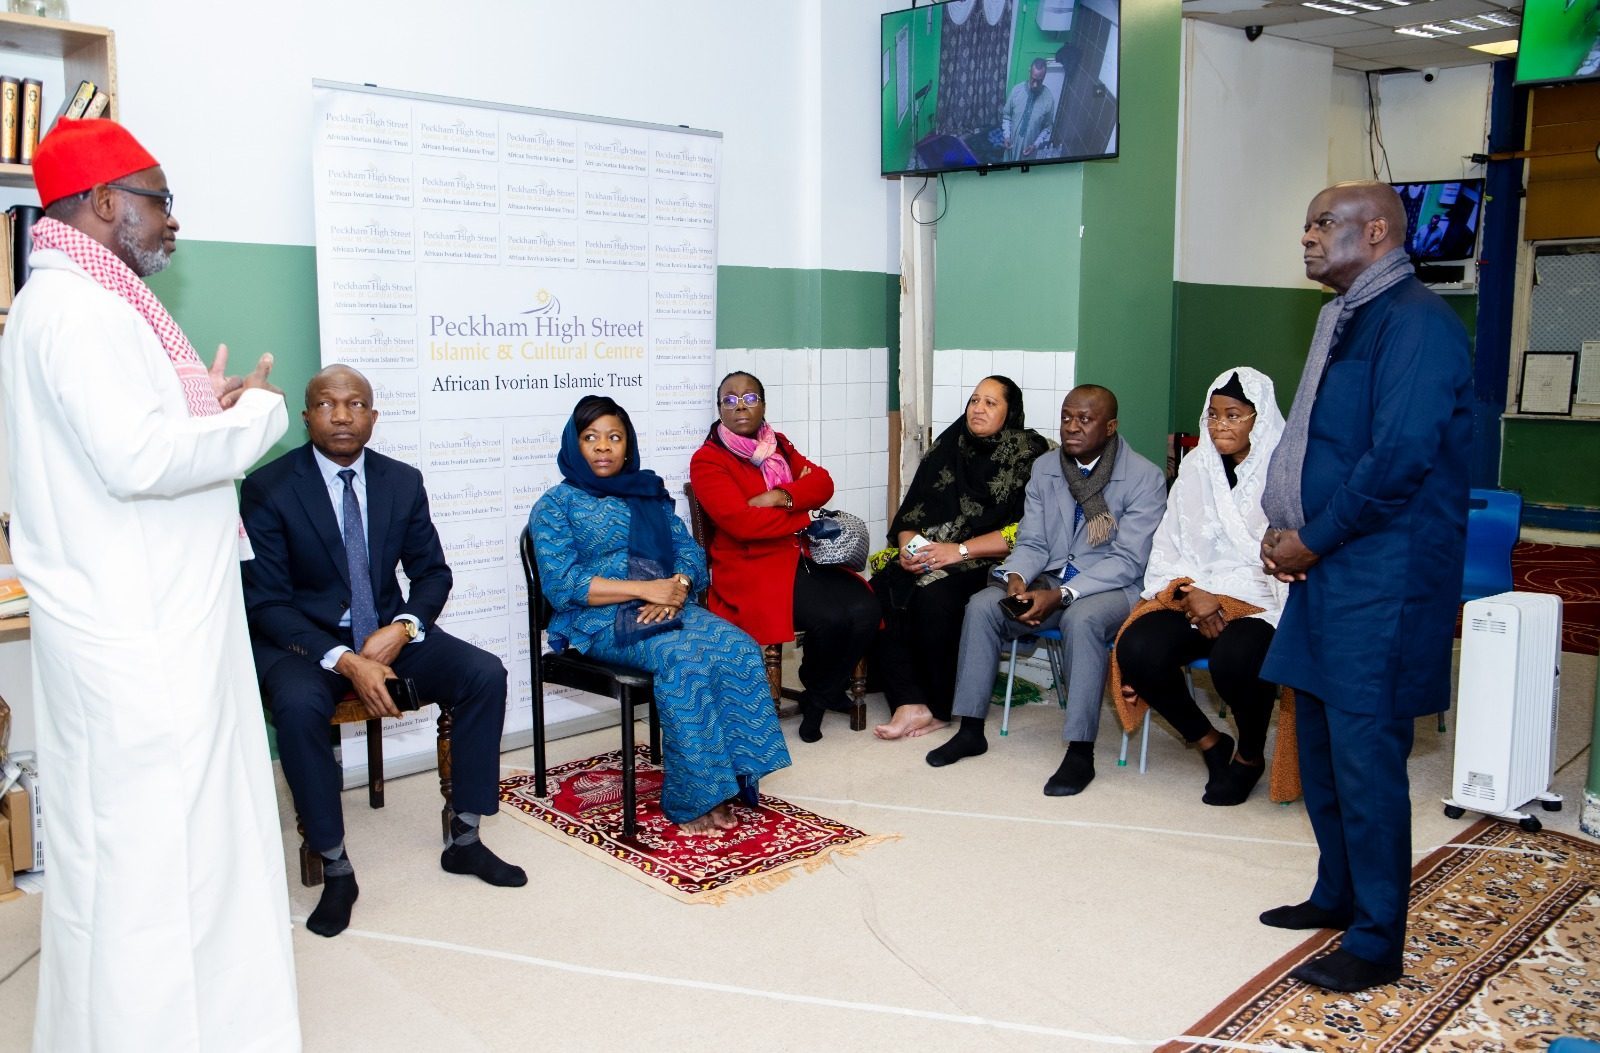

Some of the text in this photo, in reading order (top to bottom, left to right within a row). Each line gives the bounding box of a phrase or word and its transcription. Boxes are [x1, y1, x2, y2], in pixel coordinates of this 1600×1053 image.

[430, 314, 644, 343] Peckham High Street
[430, 341, 644, 360] Islamic & Cultural Centre
[432, 373, 643, 392] African Ivorian Islamic Trust
